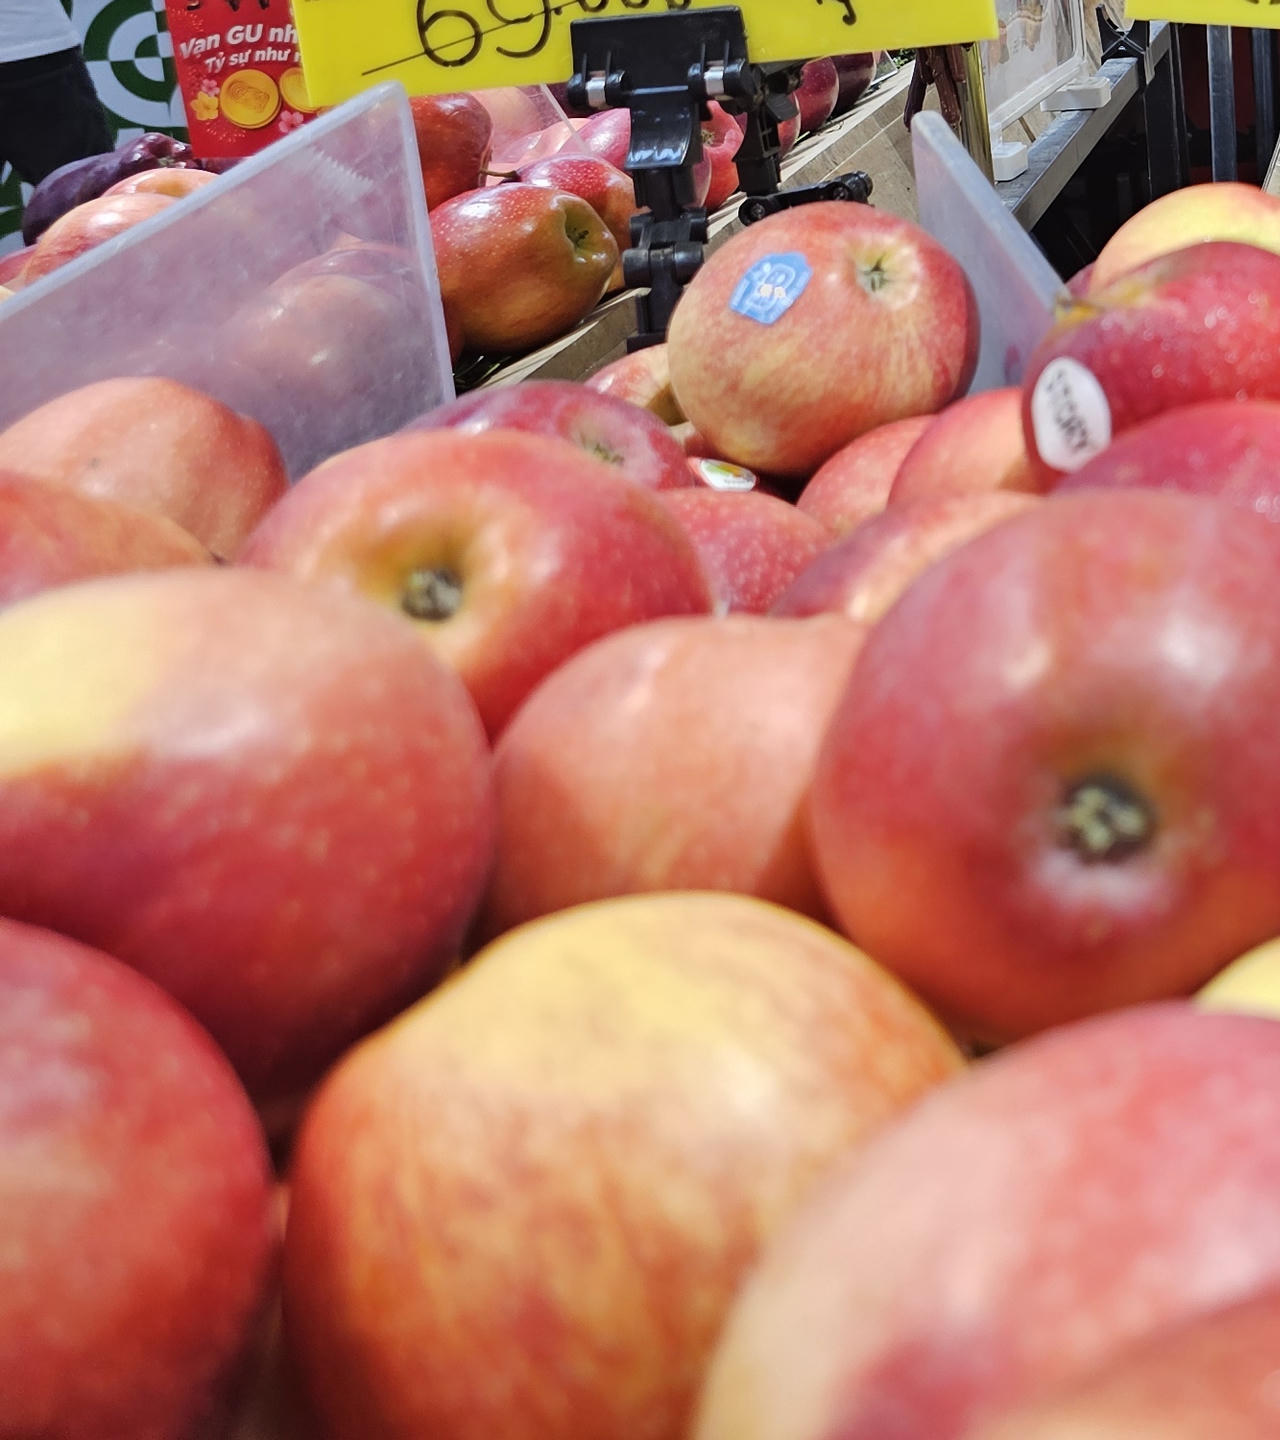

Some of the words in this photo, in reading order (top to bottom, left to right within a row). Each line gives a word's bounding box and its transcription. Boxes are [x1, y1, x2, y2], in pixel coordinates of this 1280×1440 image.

[178, 30, 221, 62] Vạn
[225, 23, 264, 47] GU
[268, 22, 298, 45] nh
[254, 45, 292, 64] như
